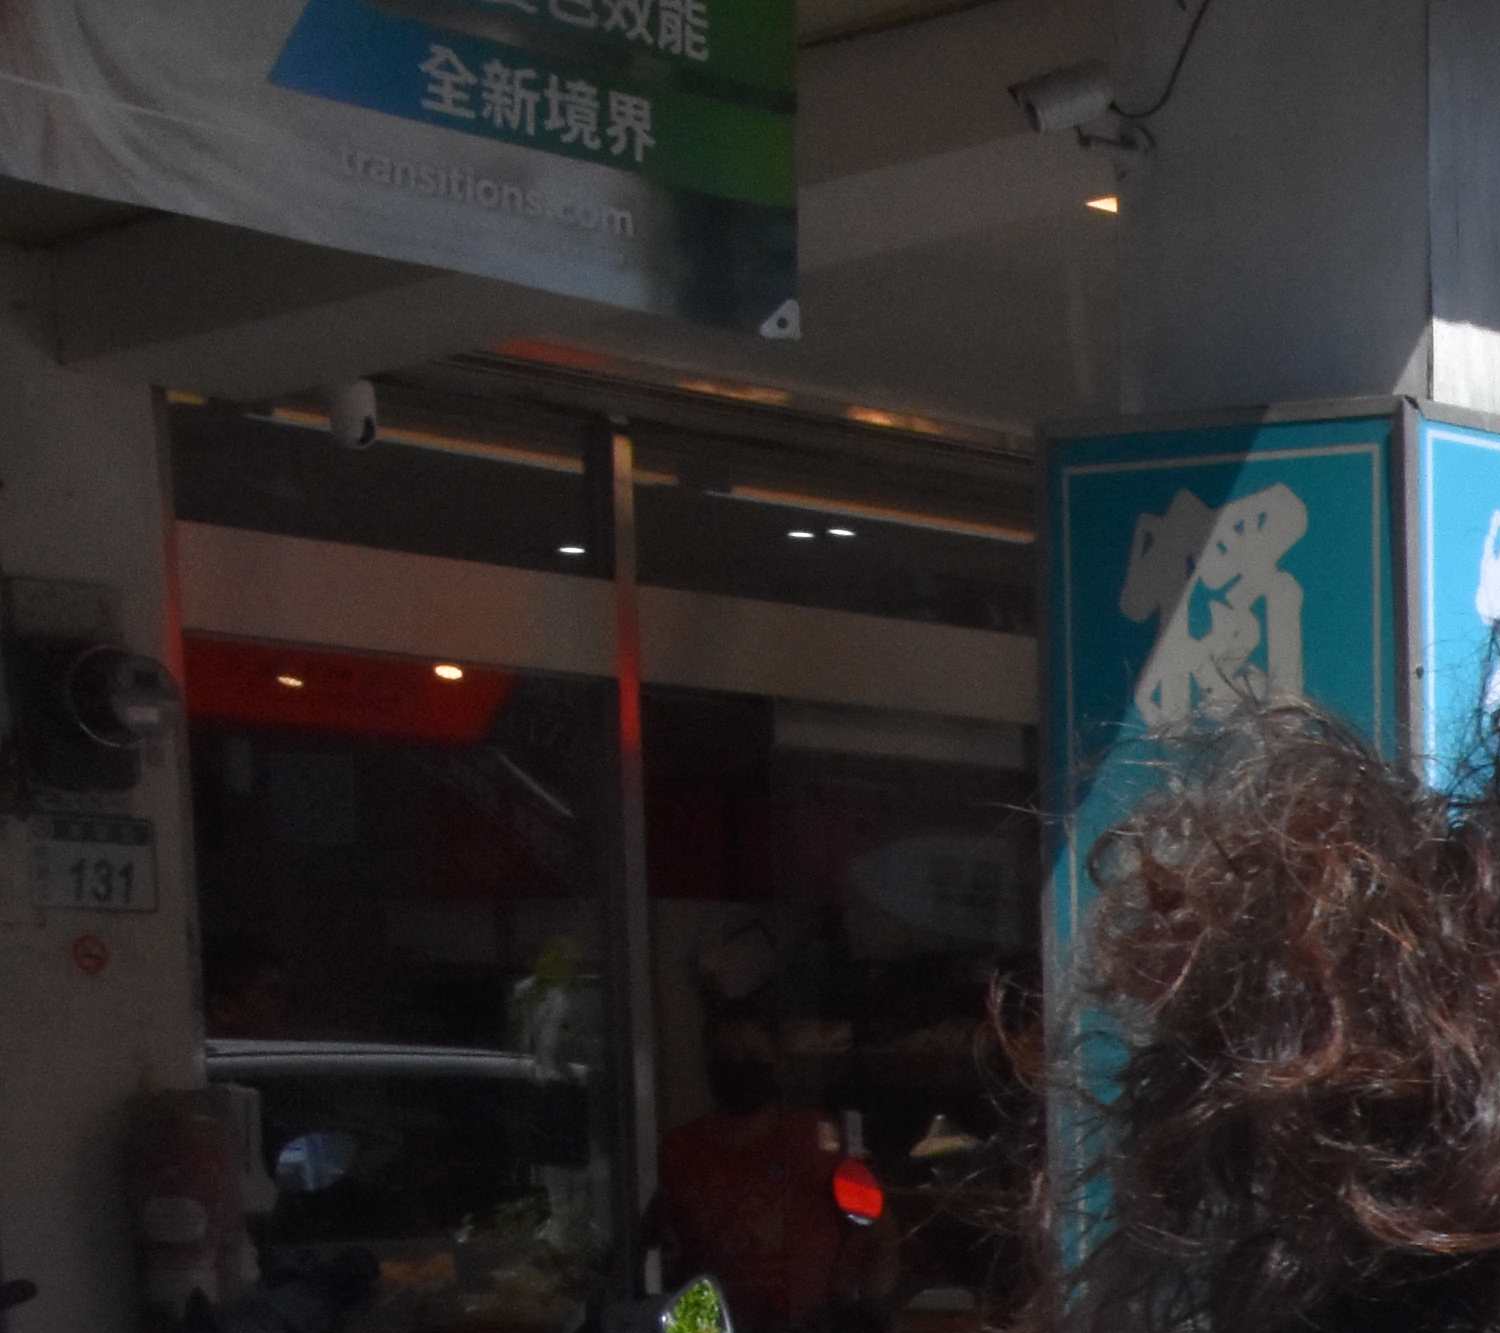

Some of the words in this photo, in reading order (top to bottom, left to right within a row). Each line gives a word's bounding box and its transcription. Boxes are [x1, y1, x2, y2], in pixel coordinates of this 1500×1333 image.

[418, 43, 656, 163] 全新境界
[340, 146, 636, 238] transitions.com
[69, 857, 134, 904] 131
